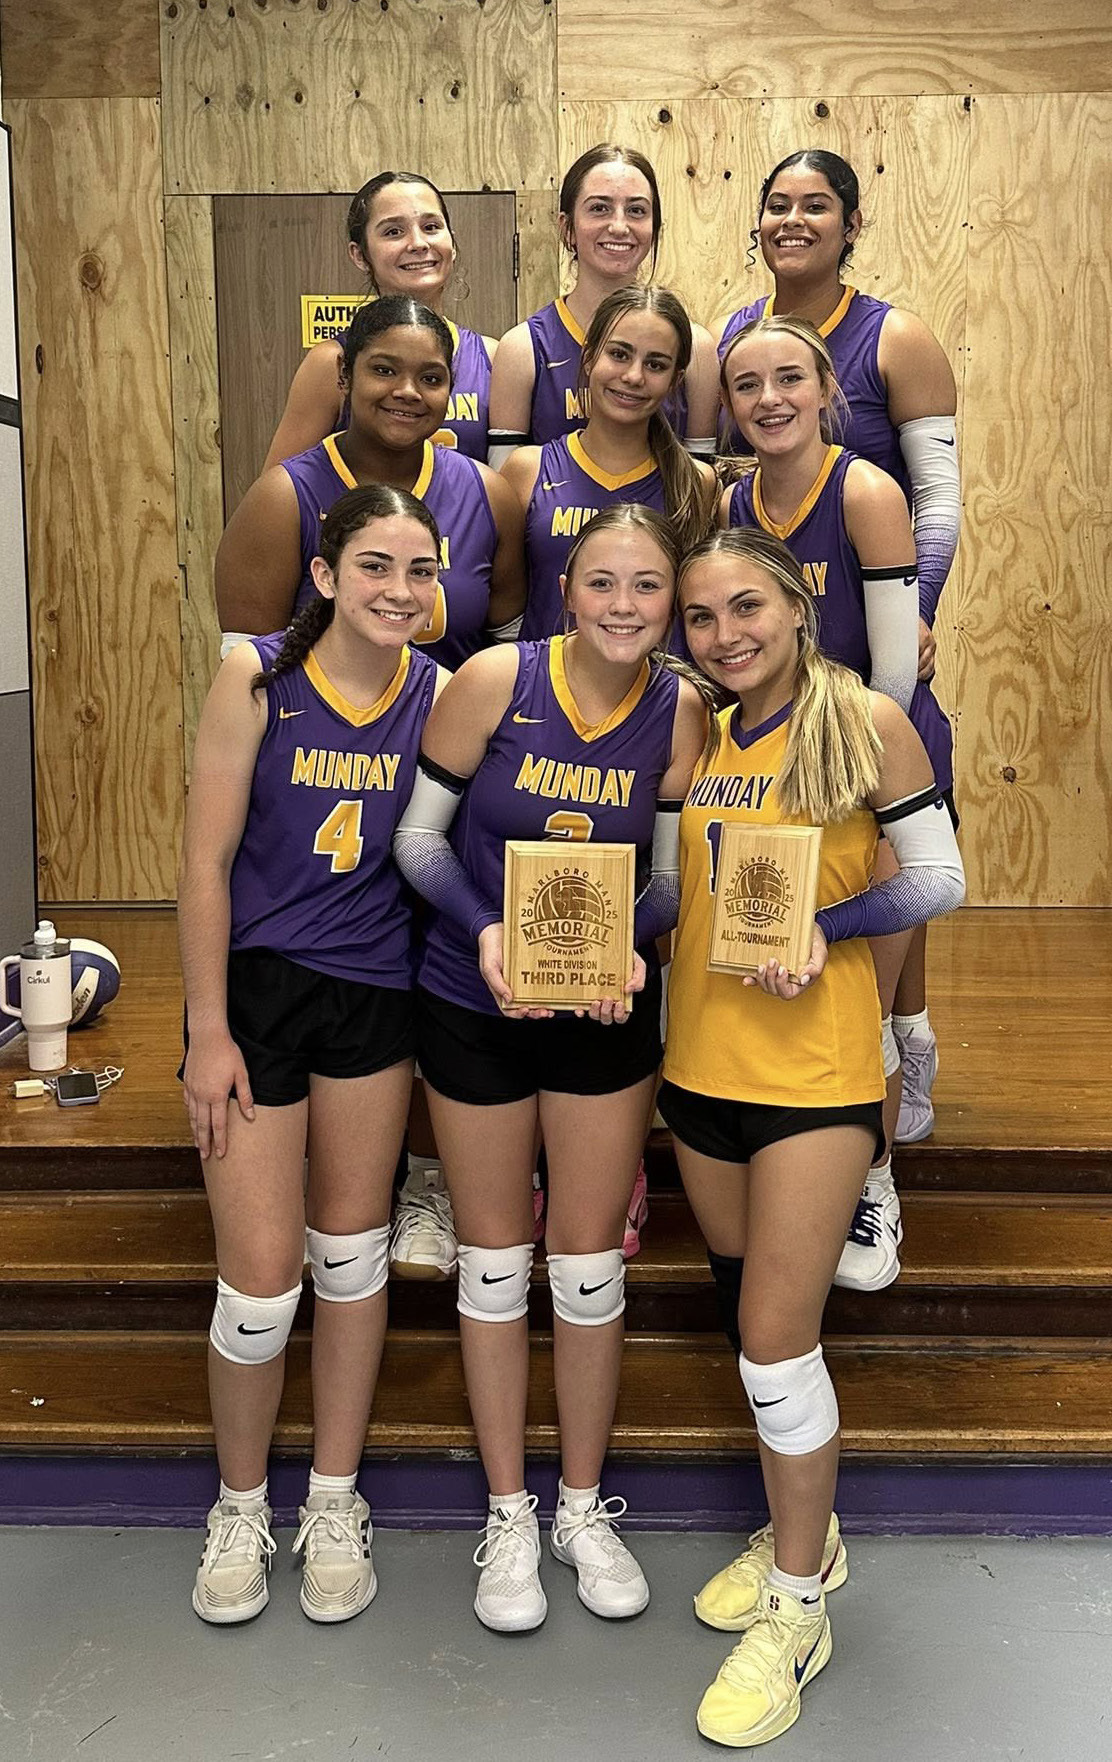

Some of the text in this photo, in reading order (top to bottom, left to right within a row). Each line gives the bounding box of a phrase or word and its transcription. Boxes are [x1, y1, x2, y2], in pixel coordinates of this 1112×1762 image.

[313, 326, 350, 340] PERS
[291, 746, 401, 791] MUNDAY
[514, 752, 637, 808] MUNDAY
[686, 774, 776, 812] MUNDAY
[313, 799, 364, 873] 4
[527, 867, 613, 906] MARLBORO MAN
[724, 888, 735, 897] 20
[785, 893, 795, 902] 25
[520, 908, 534, 918] 20
[606, 910, 618, 919] 25
[725, 899, 787, 921] MEMORIAL
[522, 920, 609, 944] MEMORIAL
[720, 929, 791, 949] ALL-TOURNAMENT
[542, 941, 594, 956] TOURNAMENT
[537, 959, 598, 971] WHITE DIVISION
[27, 976, 51, 984] Cirkul
[520, 971, 617, 987] THIRD PLACE
